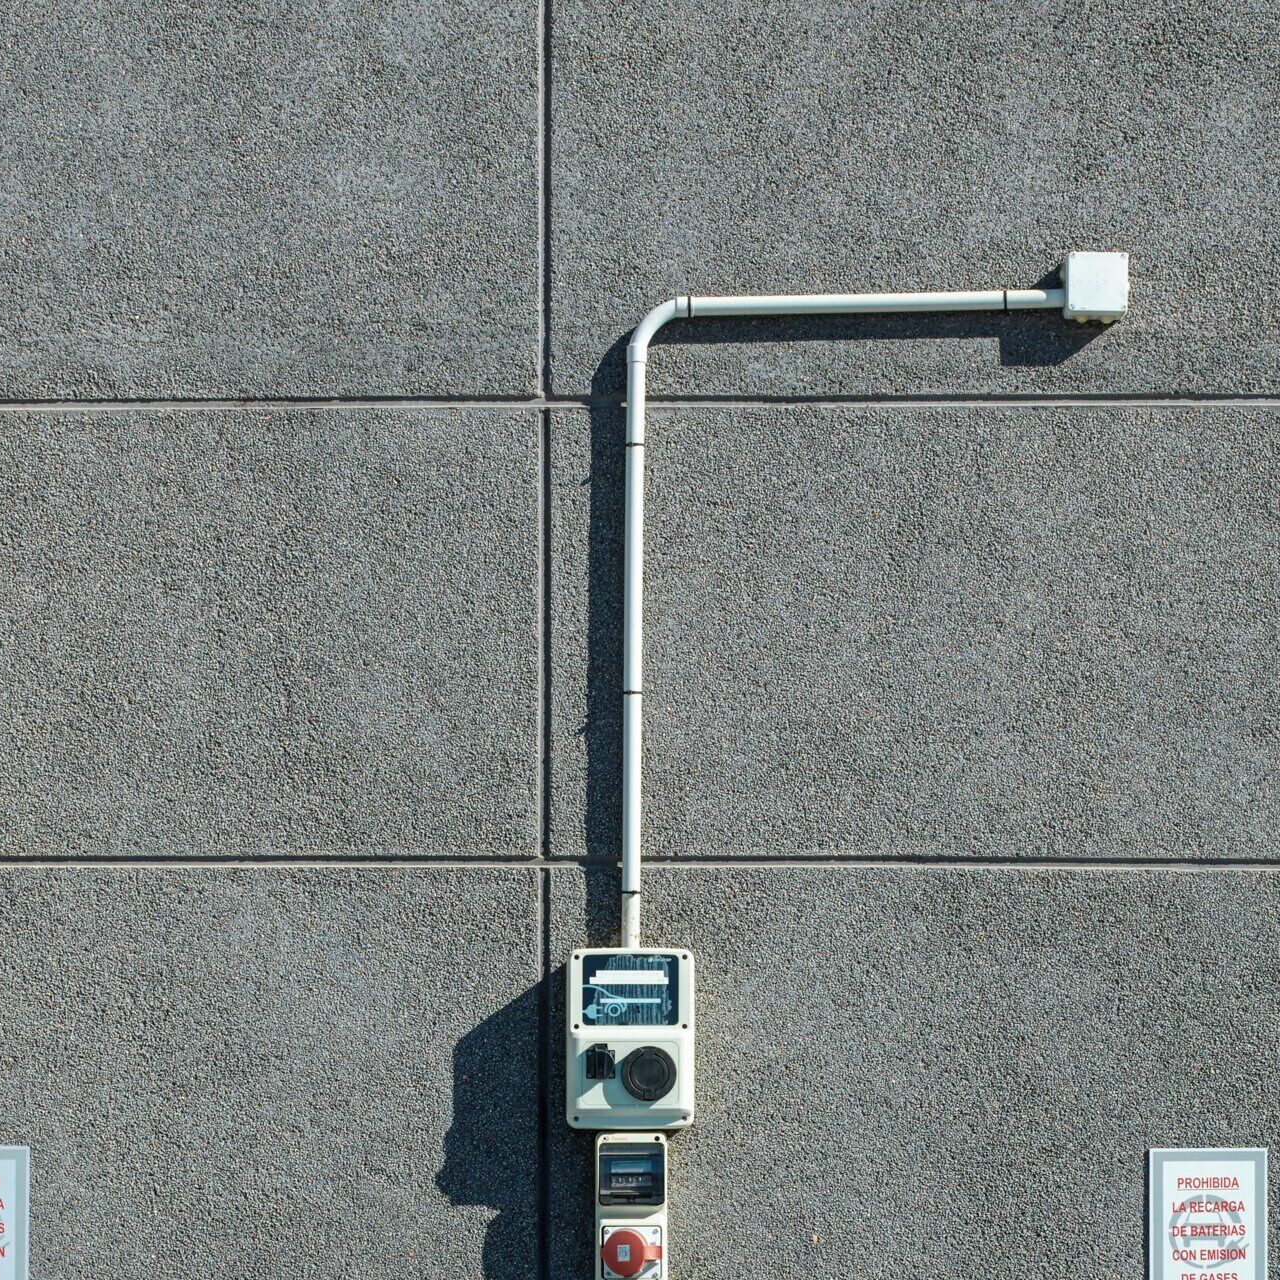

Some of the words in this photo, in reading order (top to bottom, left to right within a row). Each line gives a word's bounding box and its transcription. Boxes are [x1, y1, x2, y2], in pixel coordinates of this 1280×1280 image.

[1177, 1177, 1239, 1189] PROHIBIDA
[1172, 1202, 1186, 1213] LA
[1190, 1201, 1245, 1212] RECARGA
[1172, 1226, 1187, 1237] DE
[1190, 1225, 1246, 1236] BATERIAS
[1172, 1249, 1197, 1261] CON
[1200, 1248, 1246, 1260] EMISION
